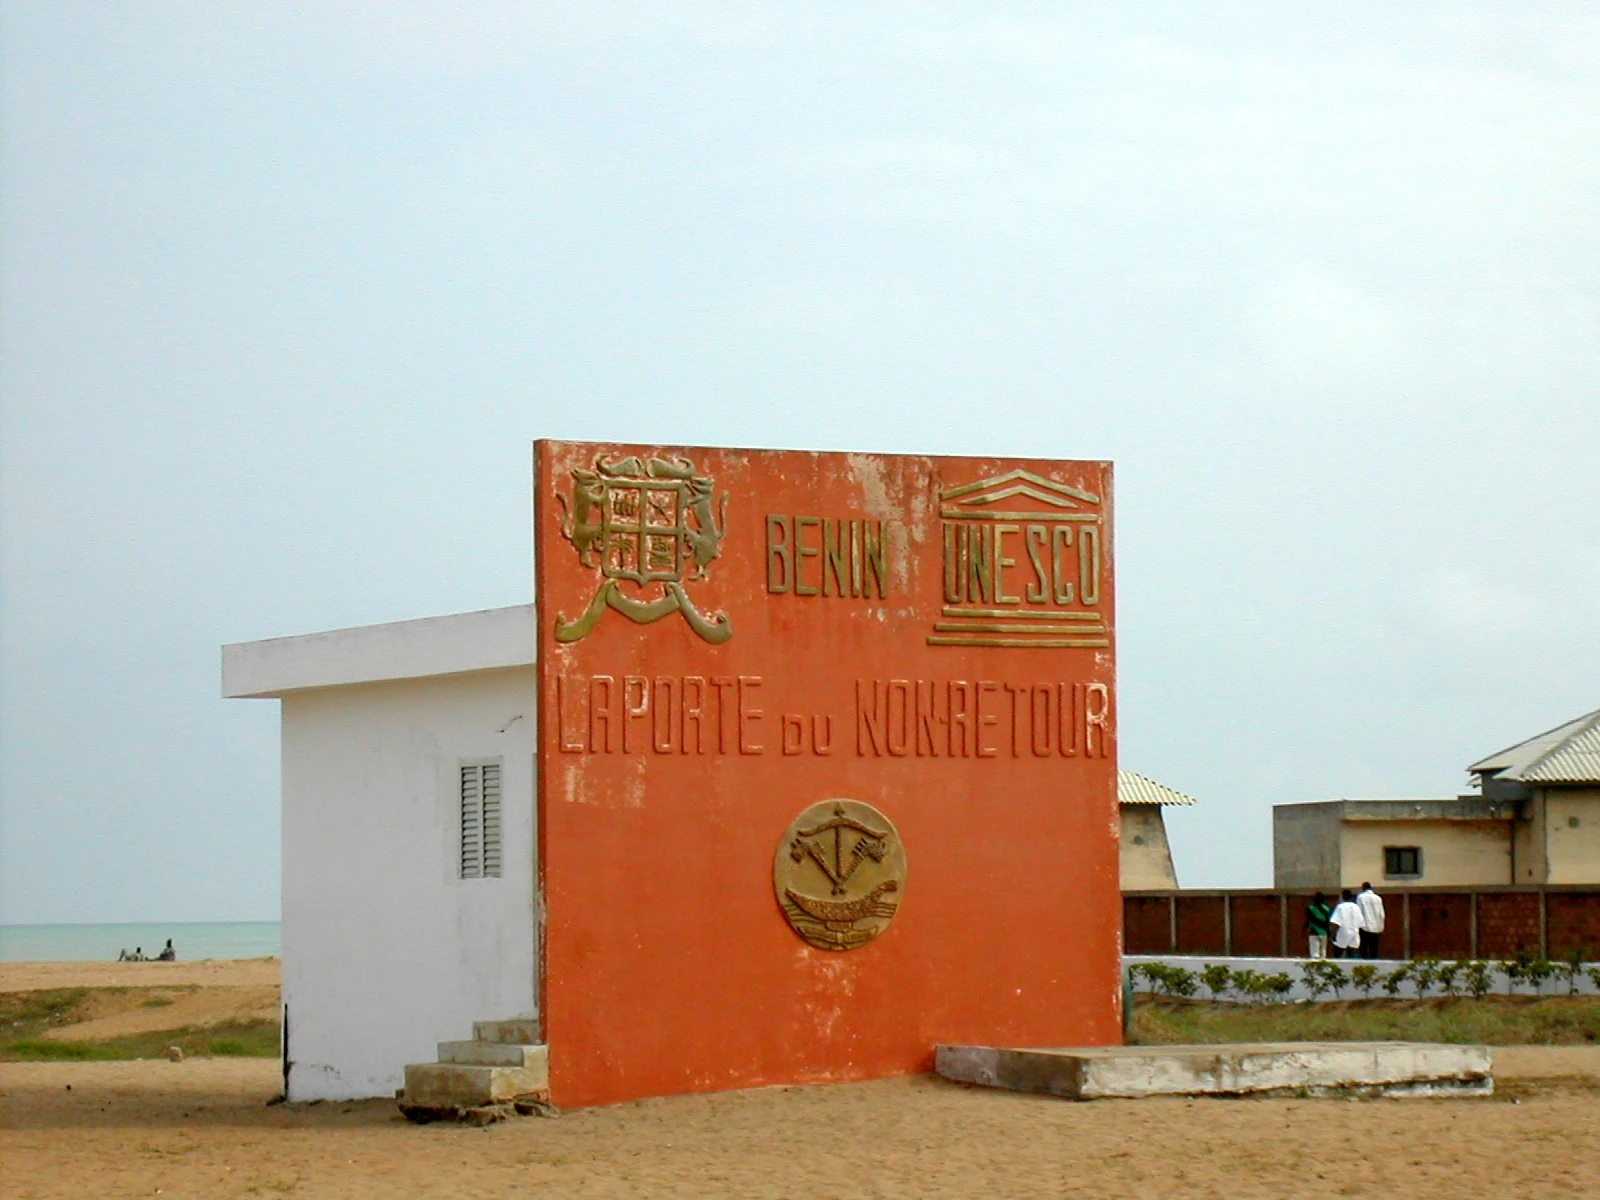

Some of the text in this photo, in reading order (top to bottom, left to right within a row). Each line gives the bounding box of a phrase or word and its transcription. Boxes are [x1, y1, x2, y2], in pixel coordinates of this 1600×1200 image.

[766, 514, 888, 600] BENIN
[943, 522, 1100, 605] UNESCO
[781, 714, 831, 757] DU
